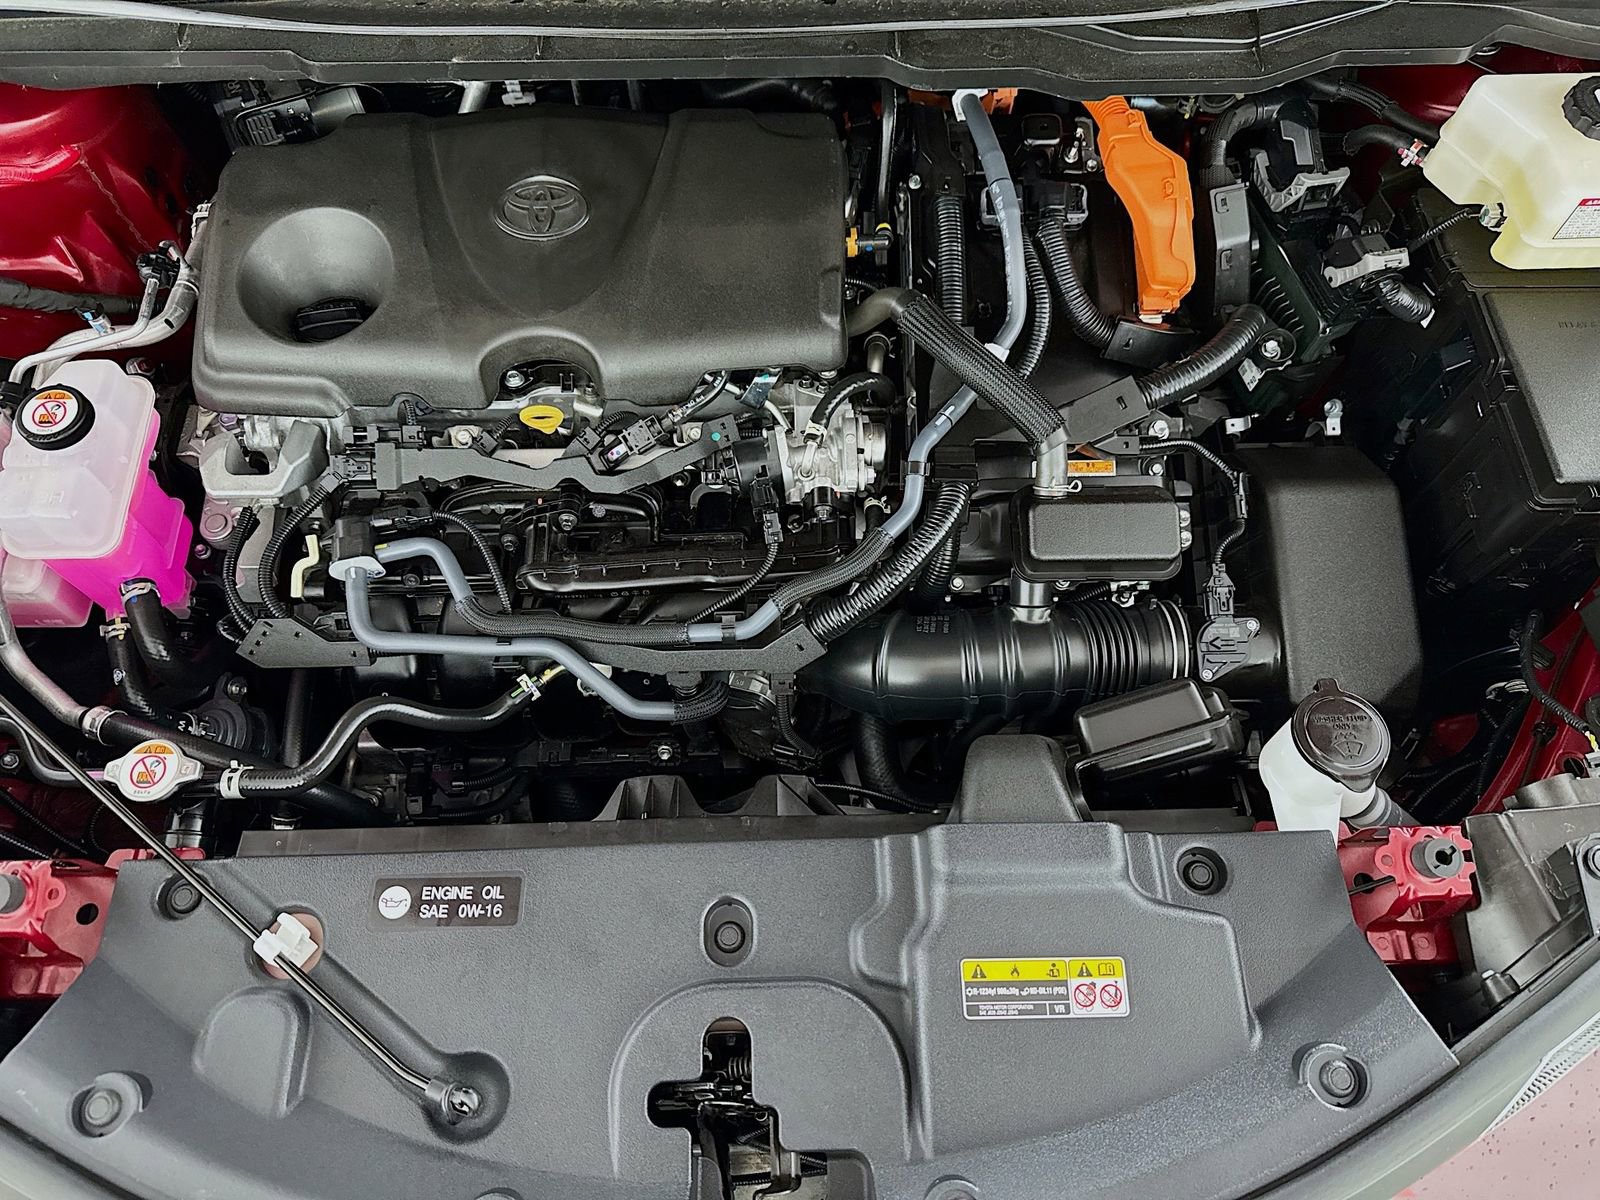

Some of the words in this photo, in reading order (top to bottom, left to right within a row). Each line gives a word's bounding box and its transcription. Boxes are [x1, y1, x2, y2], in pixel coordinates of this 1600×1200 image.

[421, 886, 473, 900] ENGINE
[481, 885, 505, 900] OIL
[419, 904, 449, 918] SAE
[458, 903, 503, 918] 0W-16
[1054, 1004, 1066, 1013] VR
